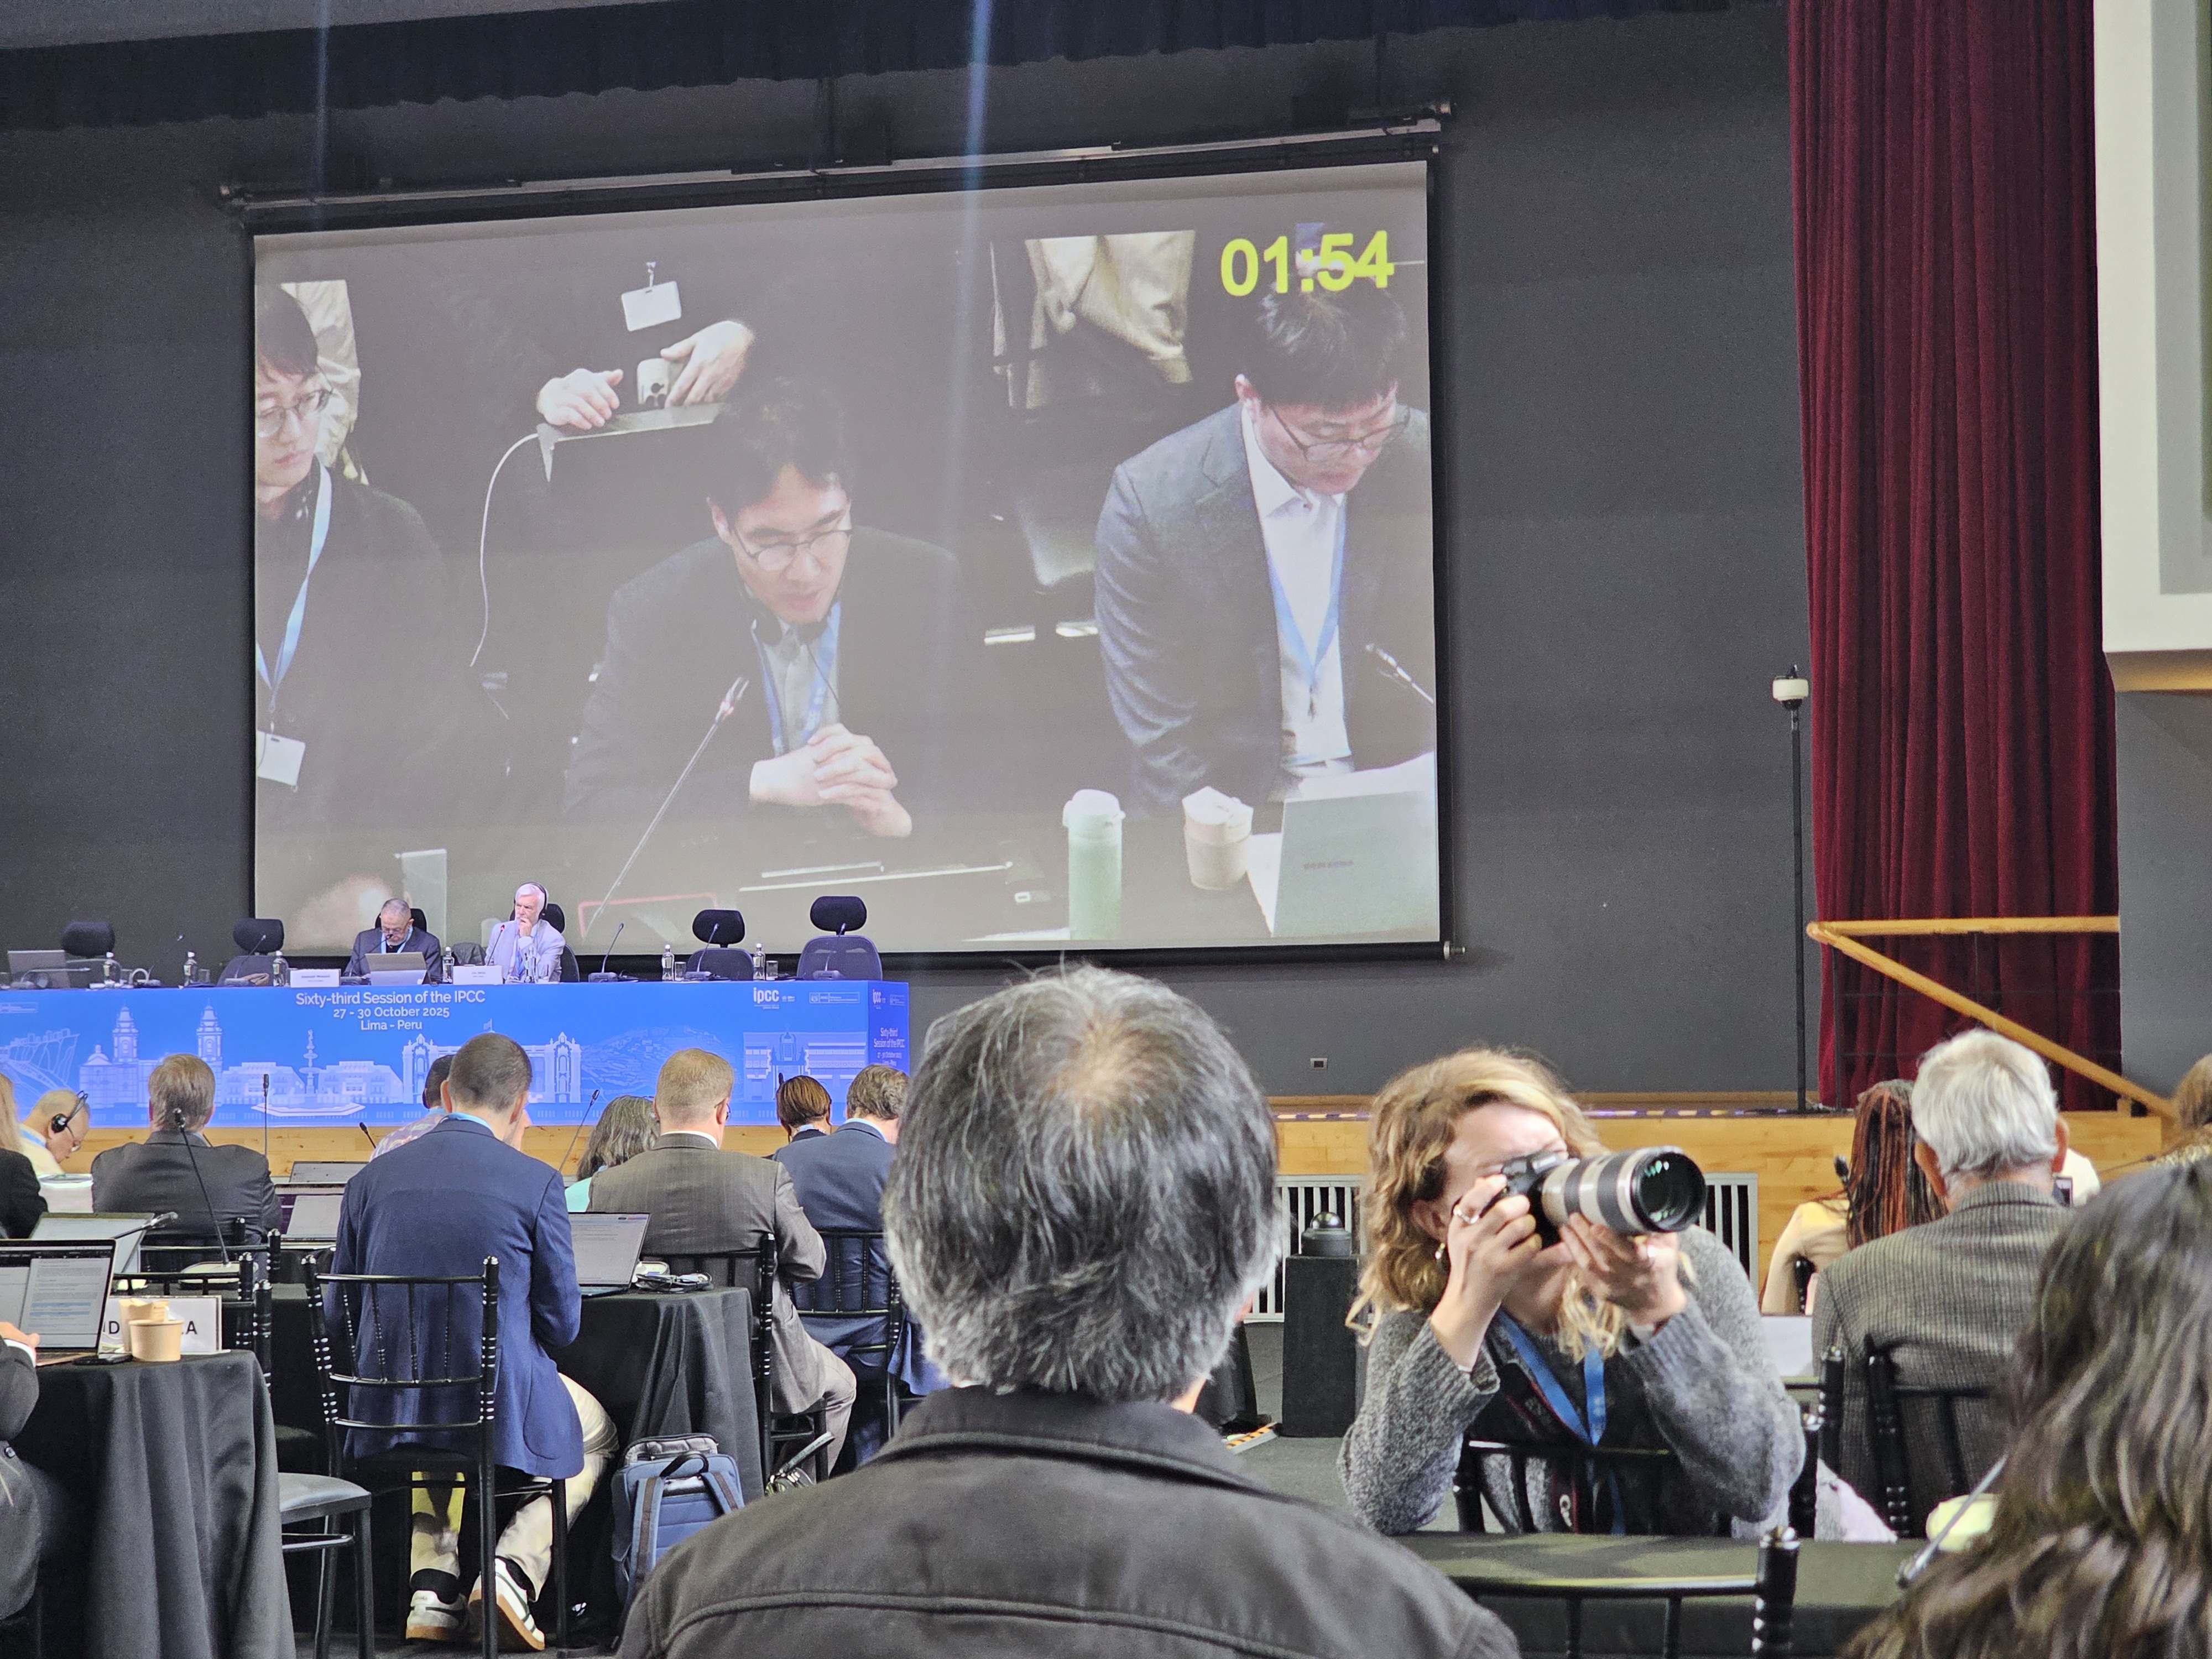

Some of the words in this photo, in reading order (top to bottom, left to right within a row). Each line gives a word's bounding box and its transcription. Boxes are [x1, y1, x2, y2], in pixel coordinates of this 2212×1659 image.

[1220, 230, 1395, 297] 01:54
[296, 992, 361, 1008] Sixty-third
[363, 991, 412, 1004] Session
[415, 990, 429, 1004] of
[430, 990, 451, 1003] the
[455, 990, 486, 1003] IPCC
[753, 987, 780, 1004] ipcc
[333, 1009, 346, 1018] 27
[357, 1008, 371, 1019] 30
[374, 1007, 420, 1018] October
[422, 1007, 450, 1018] 2025
[361, 1020, 388, 1030] Lima
[397, 1020, 422, 1030] Peru
